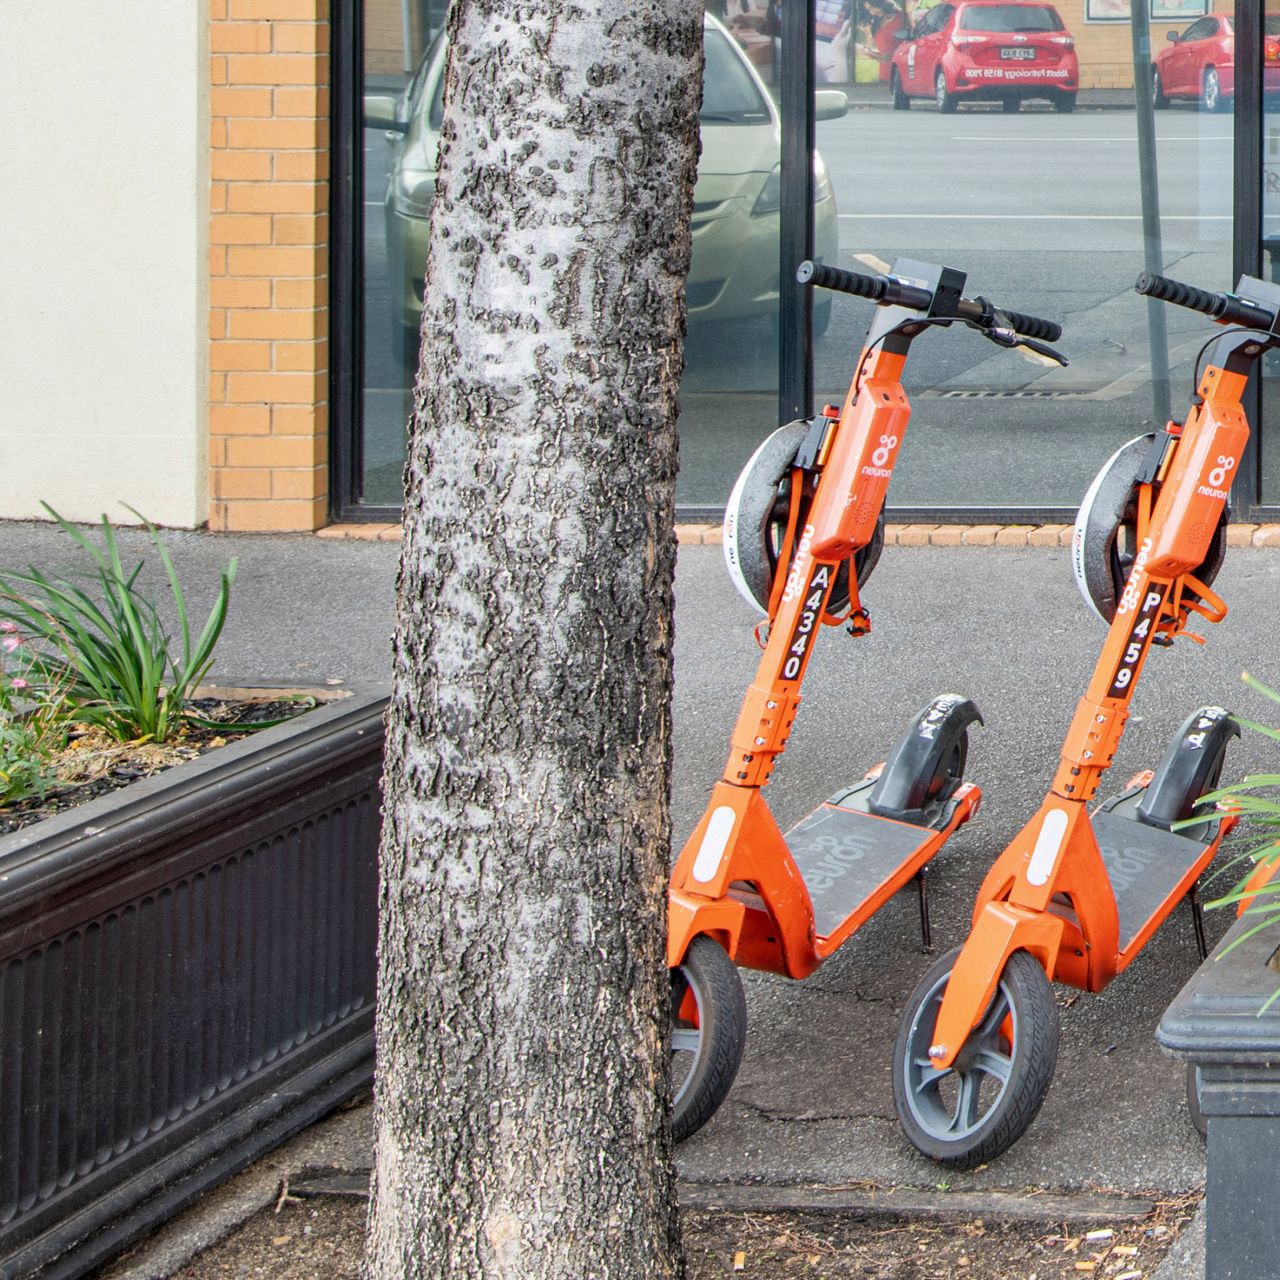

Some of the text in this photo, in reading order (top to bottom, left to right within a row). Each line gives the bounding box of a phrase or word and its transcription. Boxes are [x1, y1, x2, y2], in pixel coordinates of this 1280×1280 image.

[861, 465, 893, 479] neuron
[1197, 484, 1229, 500] neuron
[782, 524, 815, 603] neuron
[1117, 536, 1154, 616] neuron
[784, 566, 831, 680] A4340
[1114, 592, 1162, 690] P459
